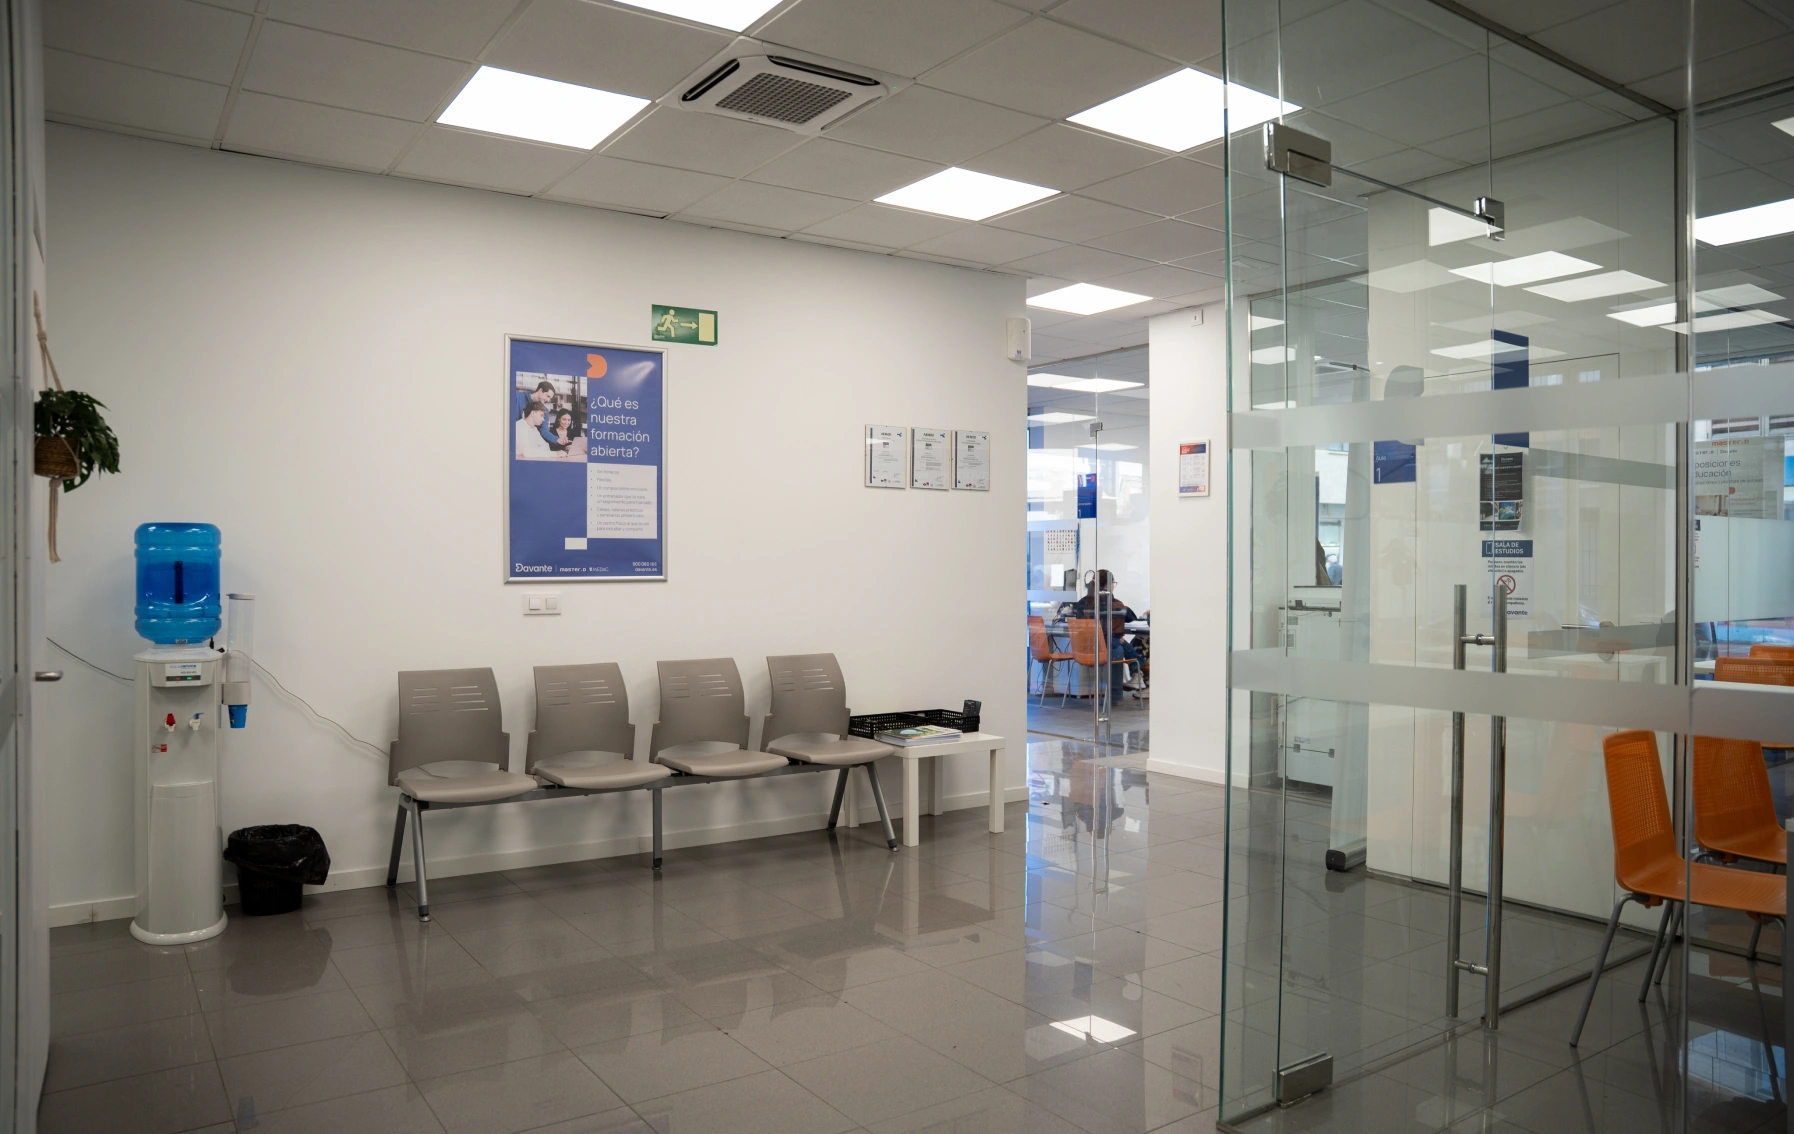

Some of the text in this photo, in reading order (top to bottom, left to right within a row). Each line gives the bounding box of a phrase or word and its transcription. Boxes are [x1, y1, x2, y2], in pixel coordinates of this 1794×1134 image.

[590, 396, 639, 410] ¿Qué es
[590, 414, 637, 426] nuestra
[590, 428, 650, 442] formación
[590, 445, 640, 458] abierta?
[1375, 467, 1381, 483] 1
[1695, 469, 1732, 478] ducación
[515, 562, 553, 573] Davante
